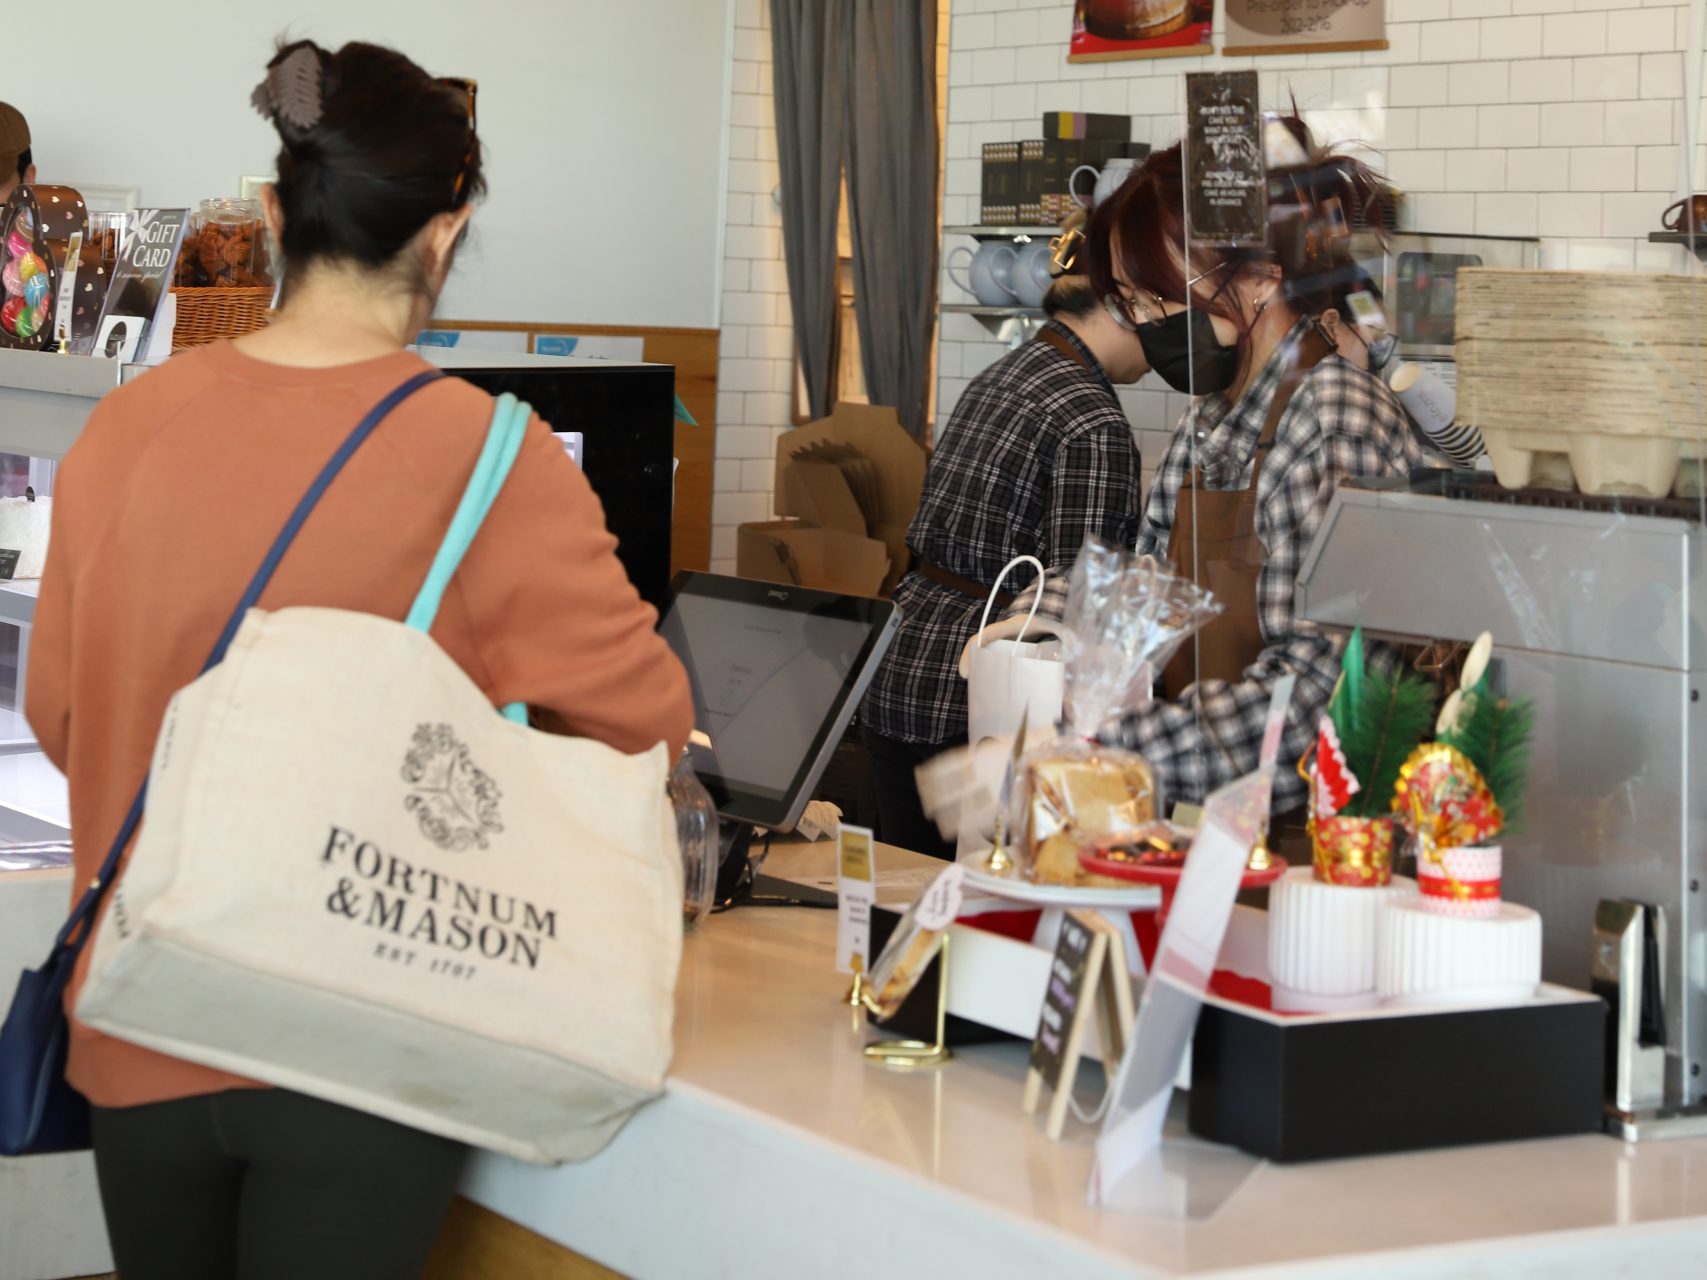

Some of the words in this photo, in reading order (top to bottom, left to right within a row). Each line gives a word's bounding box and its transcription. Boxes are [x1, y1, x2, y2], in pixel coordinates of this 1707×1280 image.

[145, 221, 180, 243] GIFT
[132, 245, 172, 267] CARD
[320, 824, 559, 939] FORTNUM
[373, 941, 416, 966] EST
[429, 958, 477, 981] 1707
